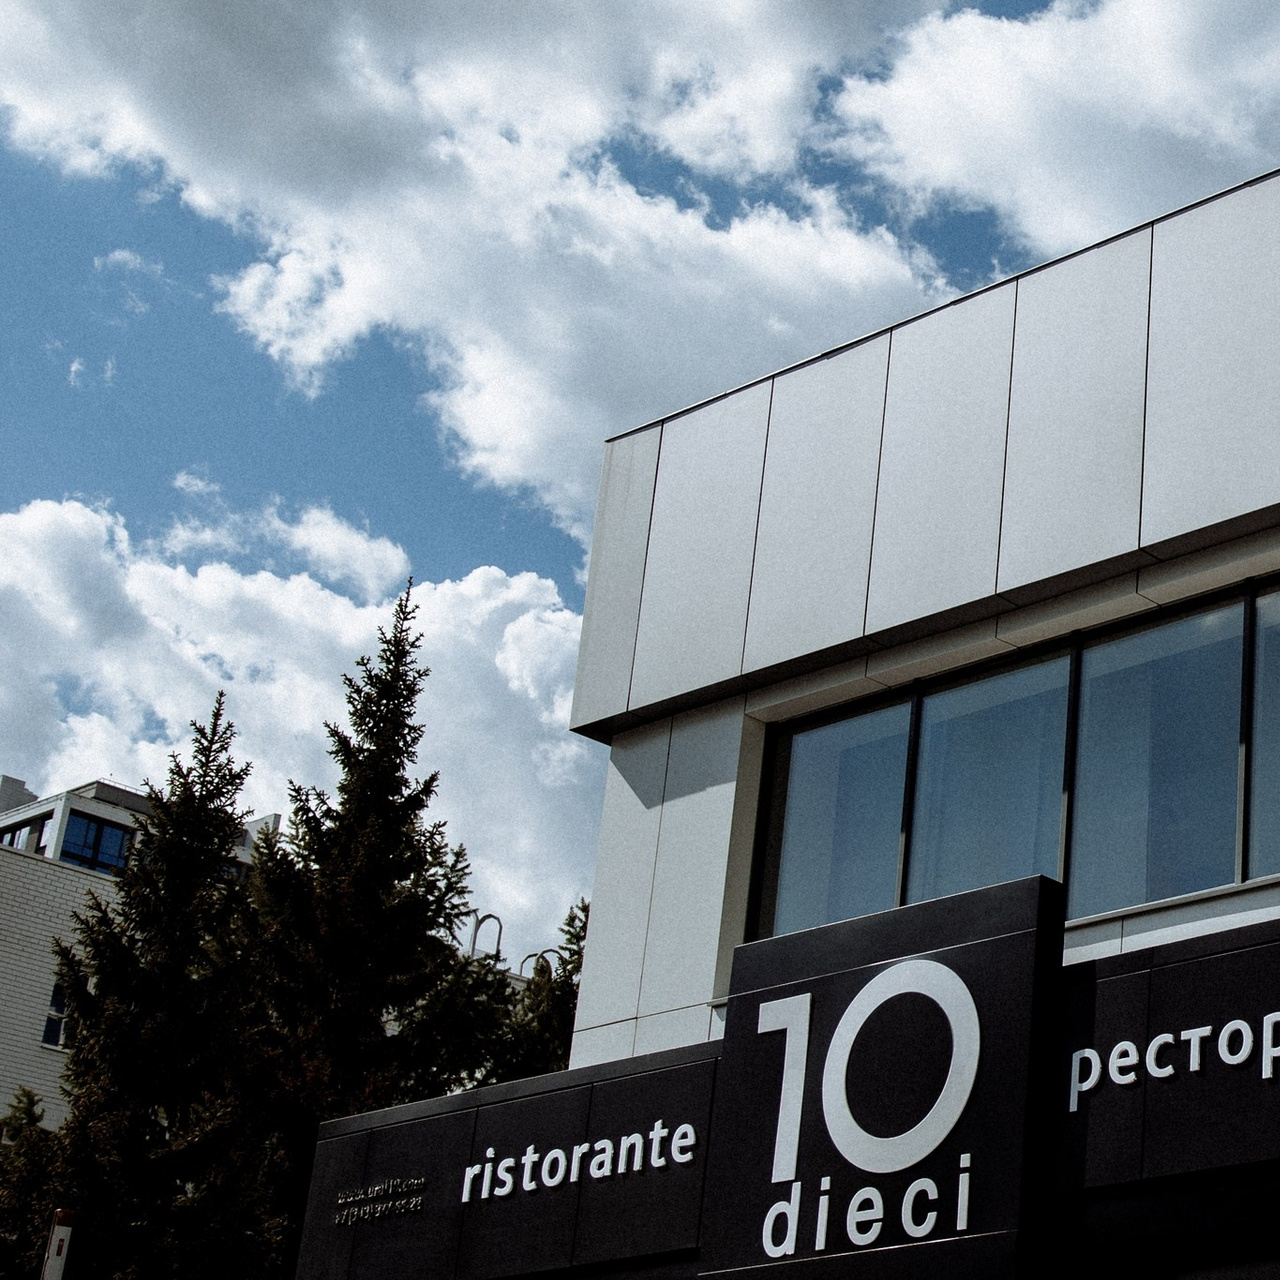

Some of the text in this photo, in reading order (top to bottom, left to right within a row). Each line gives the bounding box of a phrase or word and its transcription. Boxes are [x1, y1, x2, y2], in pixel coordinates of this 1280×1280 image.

[758, 959, 981, 1184] 10
[460, 1118, 698, 1205] ristorante
[762, 1153, 971, 1258] dieci
